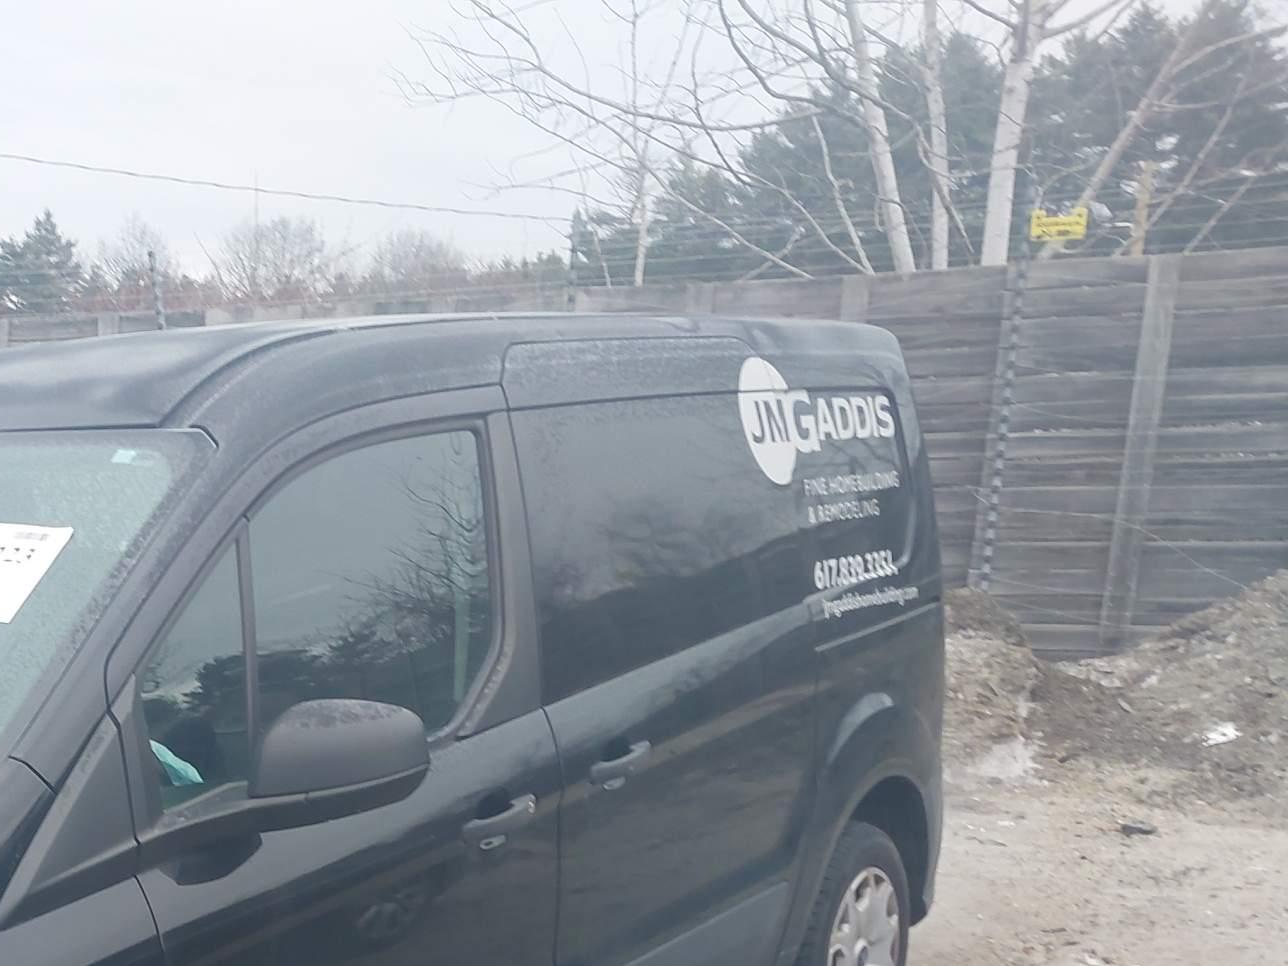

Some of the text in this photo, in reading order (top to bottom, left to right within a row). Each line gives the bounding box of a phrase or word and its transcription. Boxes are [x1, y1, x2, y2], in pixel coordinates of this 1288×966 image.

[803, 469, 900, 497] FINE HOMEBUILDING
[817, 498, 880, 522] REMODELING
